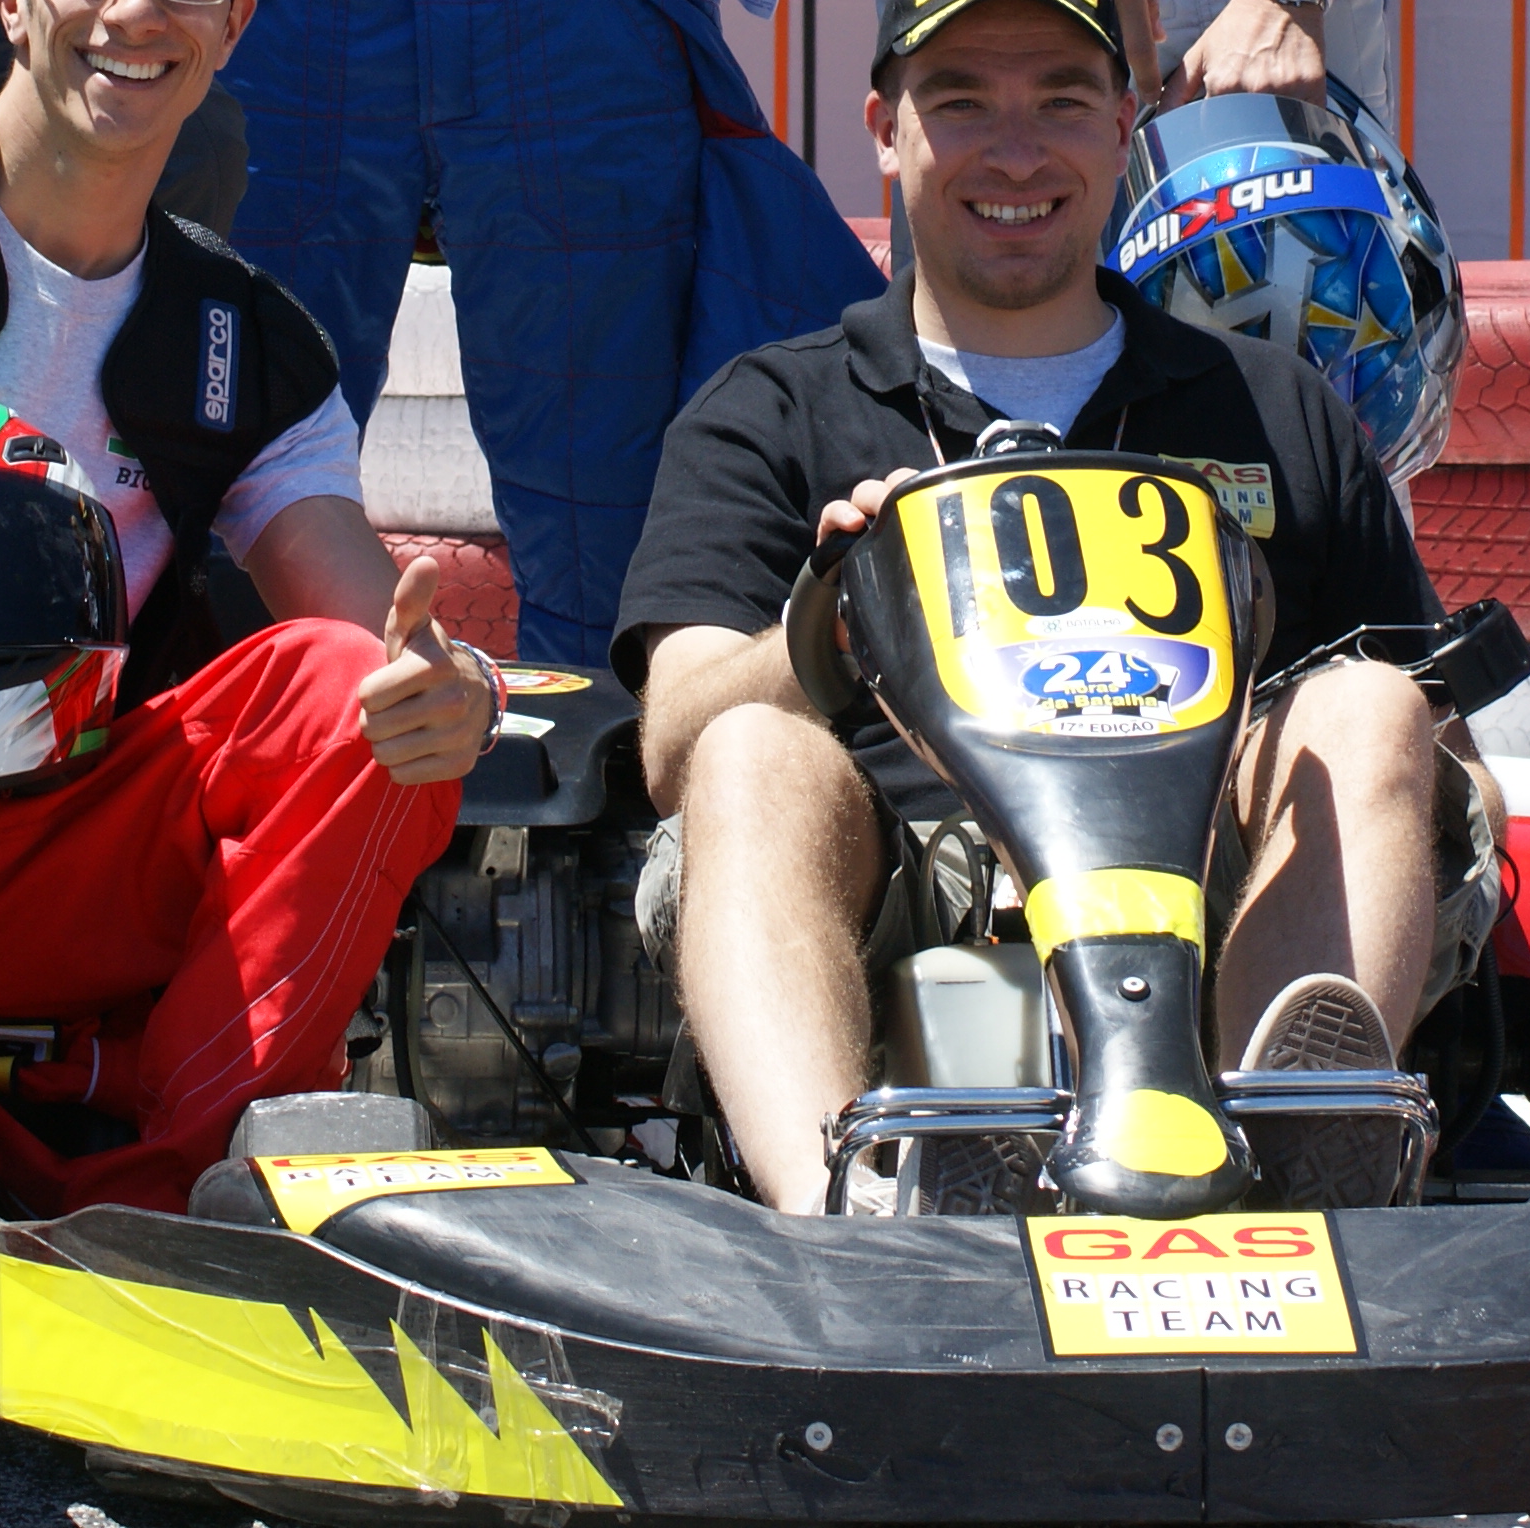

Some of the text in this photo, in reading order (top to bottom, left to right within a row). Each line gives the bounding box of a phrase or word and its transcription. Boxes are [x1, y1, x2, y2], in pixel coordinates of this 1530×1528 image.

[204, 306, 235, 424] sparco
[1202, 462, 1267, 484] AS
[1221, 490, 1267, 506] ING
[935, 474, 1204, 640] 103
[1040, 651, 1132, 693] 24
[1063, 682, 1119, 695] horas
[1041, 692, 1159, 710] da Batalha
[1090, 718, 1155, 734] EDIÇÃO
[271, 1151, 538, 1168] GAS
[345, 1171, 503, 1187] TEAM
[1043, 1226, 1316, 1261] GAS
[1061, 1275, 1318, 1300] RACING
[1112, 1309, 1284, 1332] TEAM
